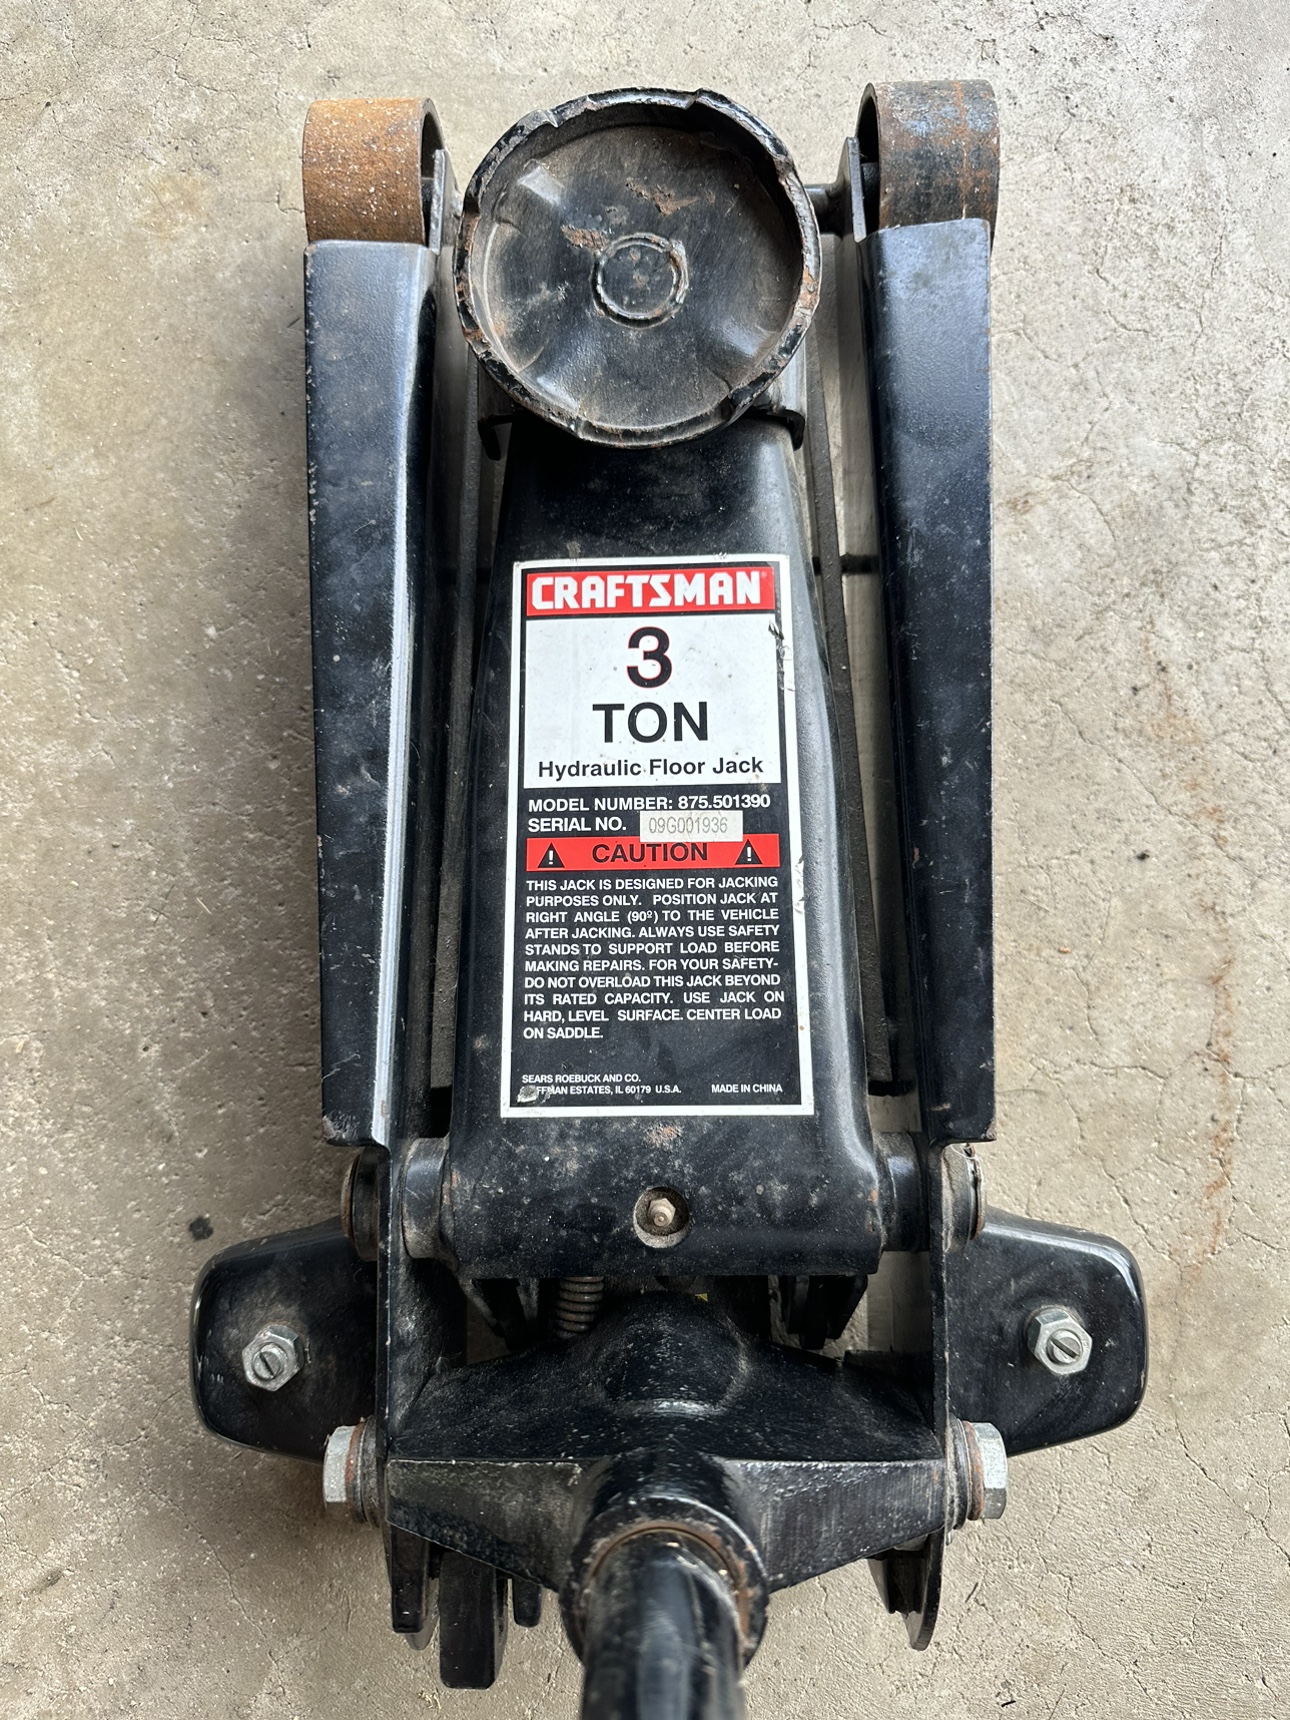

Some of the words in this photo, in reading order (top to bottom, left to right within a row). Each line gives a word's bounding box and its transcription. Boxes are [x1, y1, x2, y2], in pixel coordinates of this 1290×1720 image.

[531, 571, 761, 610] CRAFTSMAN
[626, 626, 672, 689] 3
[592, 701, 708, 743] TON
[538, 759, 642, 781] Hydraulic
[649, 758, 706, 776] Floor
[712, 757, 764, 774] Jack
[528, 798, 590, 812] MODEL
[594, 796, 673, 811] NUMBER:
[677, 794, 771, 809] 875.501390
[527, 816, 592, 832] SERIAL
[595, 817, 627, 831] NO.
[648, 816, 728, 834] 09G001936
[591, 843, 708, 863] CAUTION
[526, 880, 557, 891] THIS
[560, 879, 596, 891] JACK
[599, 879, 612, 890] IS
[615, 878, 684, 890] DESIGNED
[687, 878, 715, 889] FOR
[718, 876, 778, 888] JACKING
[526, 895, 599, 907] PURPOSES
[602, 894, 642, 906] ONLY.
[653, 893, 717, 905] POSITION
[720, 892, 757, 904] JACK
[760, 892, 778, 904] AT
[526, 911, 568, 923] RIGHT
[574, 911, 620, 922] ANGLE
[662, 910, 681, 921] TO
[687, 909, 715, 921] THE
[721, 908, 779, 920] VEHICLE
[525, 927, 569, 939] AFTER
[571, 926, 635, 938] JACKING.
[638, 926, 695, 938] ALWAYS
[697, 925, 725, 937] USE
[728, 924, 780, 937] SAFETY
[525, 943, 580, 956] STANDS
[583, 943, 601, 955] TO
[608, 943, 673, 954] SUPPORT
[680, 942, 717, 954] LOAD
[724, 941, 780, 953] BEFORE
[525, 960, 579, 972] MAKING
[583, 959, 645, 971] REPAIRS.
[649, 959, 677, 970] FOR
[680, 958, 719, 970] YOUR
[524, 977, 545, 988] DO
[547, 976, 576, 988] NOT
[578, 976, 651, 988] OVERLOAD
[653, 975, 684, 987] THIS
[686, 974, 722, 986] JACK
[724, 973, 781, 986] BEYOND
[524, 994, 545, 1005] ITS
[553, 993, 597, 1005] RATED
[604, 992, 674, 1004] CAPACITY.
[683, 991, 711, 1003] USE
[719, 991, 756, 1003] JACK
[763, 990, 785, 1002] ON
[523, 1010, 565, 1024] HARD,
[568, 1010, 609, 1022] LEVEL
[617, 1008, 684, 1021] SURFACE.
[686, 1008, 741, 1020] CENTER
[744, 1007, 782, 1019] LOAD
[523, 1027, 544, 1039] ON
[546, 1027, 604, 1039] SADDLE.
[521, 1074, 554, 1084] SEARS
[555, 1073, 601, 1083] ROEBUCK
[602, 1073, 623, 1082] AND
[624, 1073, 642, 1082] CO.
[569, 1085, 614, 1096] ESTATES,
[615, 1085, 624, 1094] IL
[625, 1084, 652, 1094] 60179
[655, 1084, 682, 1094] U.S.A.
[711, 1083, 739, 1094] MADE
[740, 1083, 751, 1093] IN
[752, 1083, 783, 1093] CHINA
